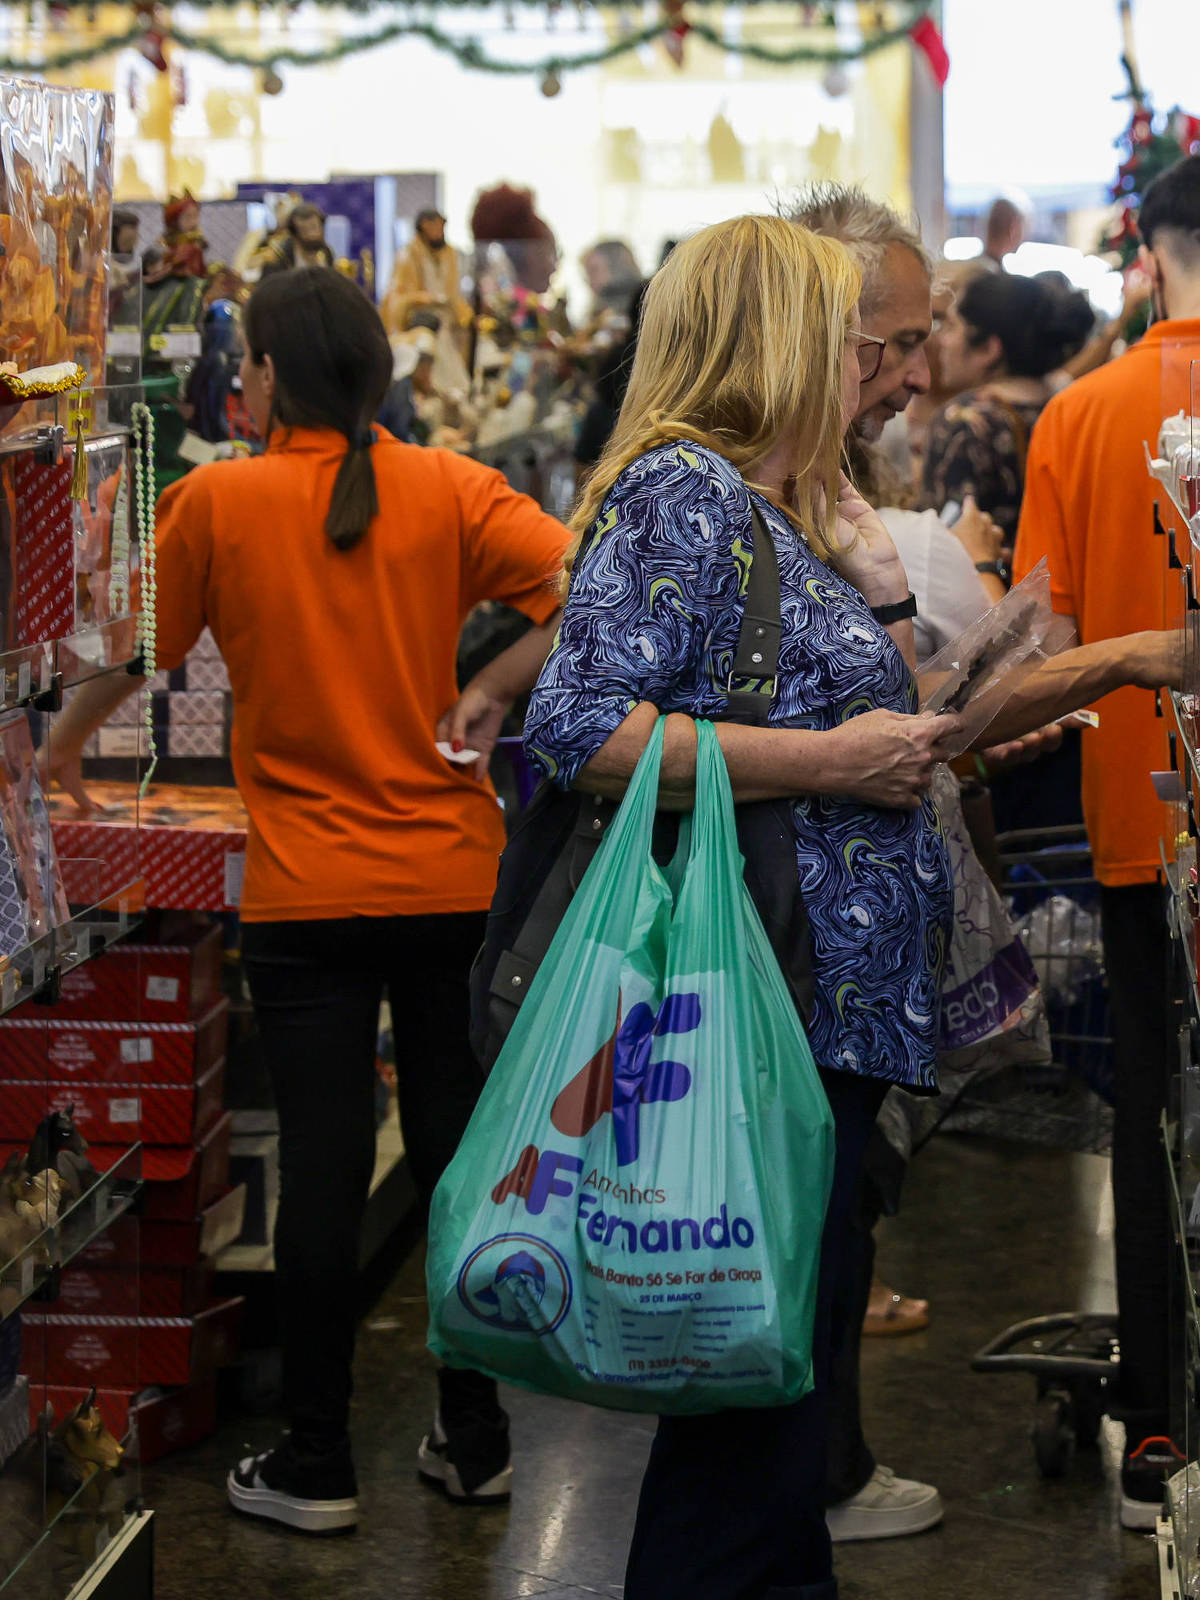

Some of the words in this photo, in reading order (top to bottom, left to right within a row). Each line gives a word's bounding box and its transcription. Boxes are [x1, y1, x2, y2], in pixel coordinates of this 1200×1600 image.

[666, 1272, 683, 1286] Se
[685, 1270, 706, 1285] For
[709, 1268, 726, 1283] de
[728, 1268, 762, 1283] Graça
